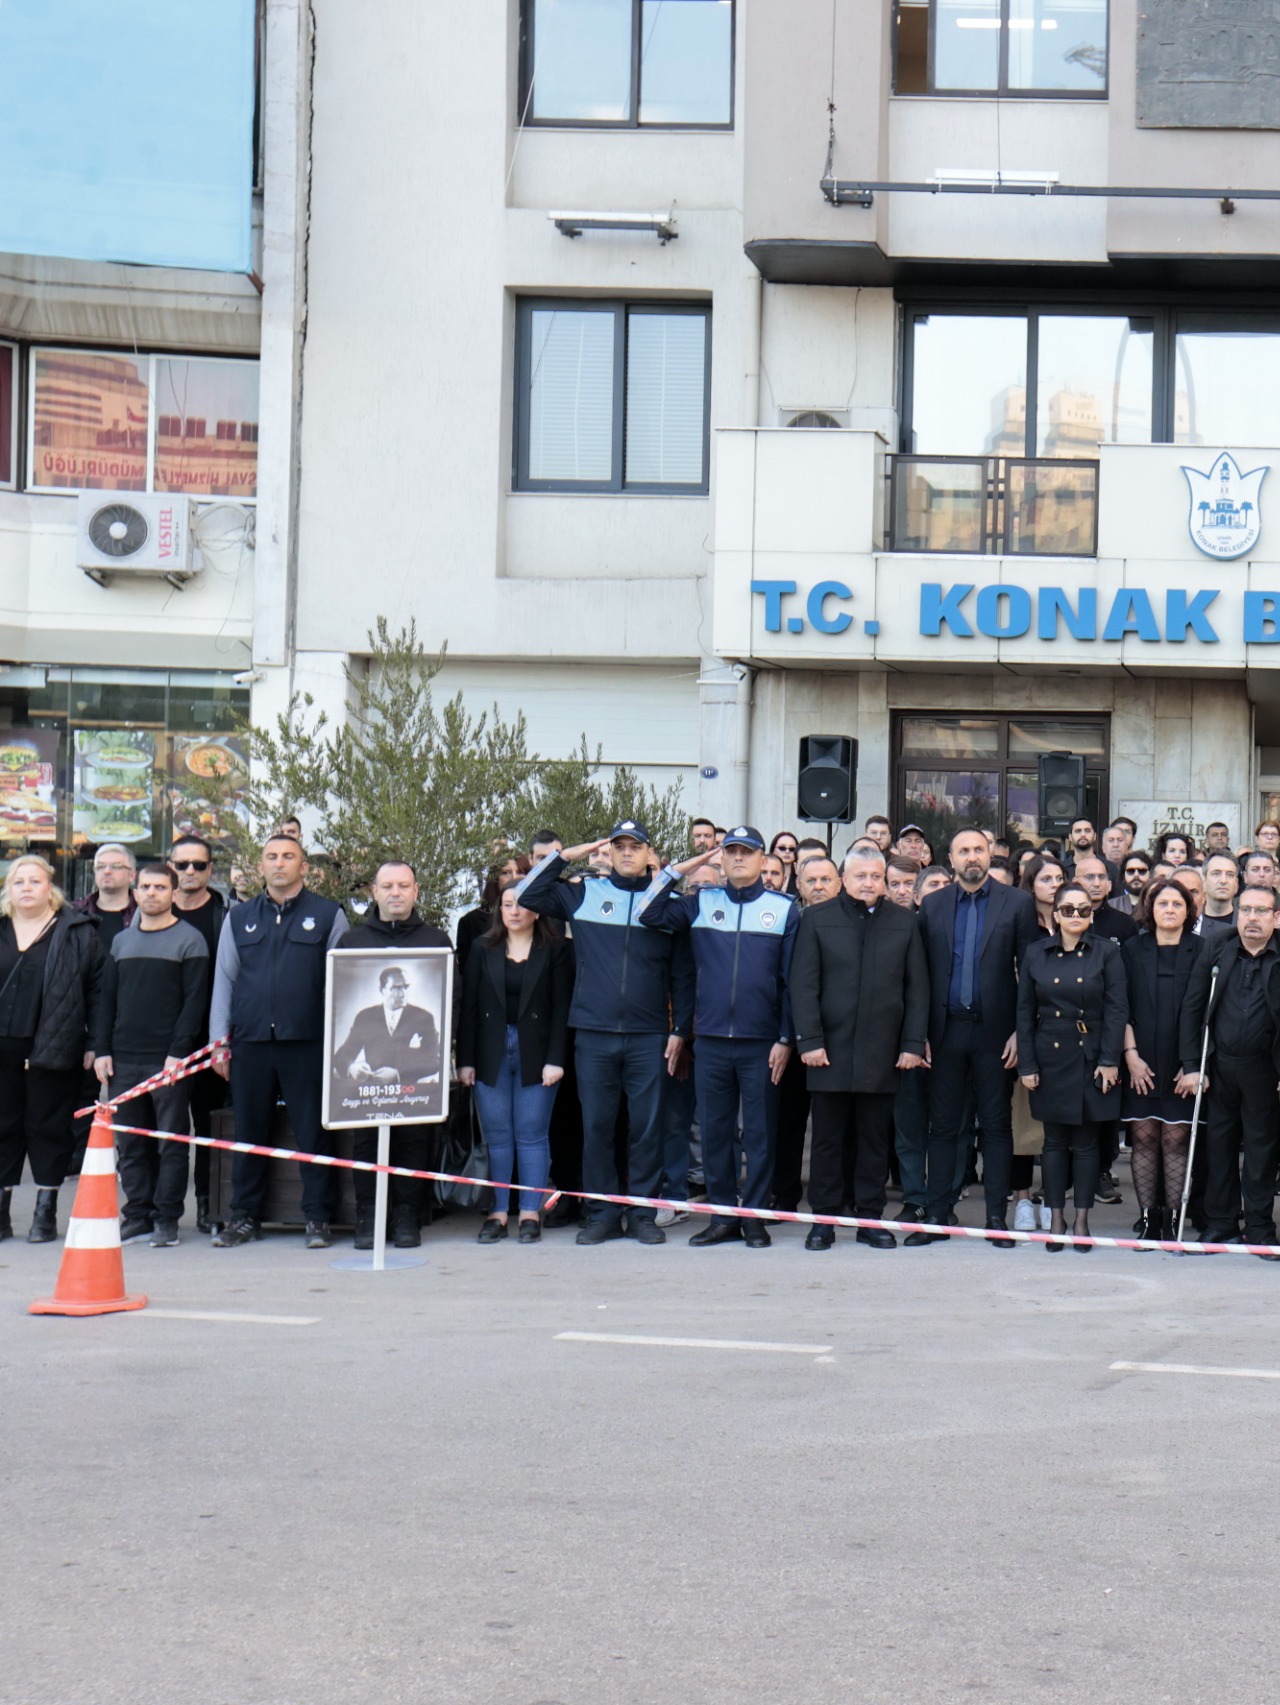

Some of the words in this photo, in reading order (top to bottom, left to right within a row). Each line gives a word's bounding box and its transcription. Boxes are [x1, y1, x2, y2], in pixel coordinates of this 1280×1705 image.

[159, 506, 172, 558] VESTEL
[1196, 529, 1216, 551] KONAK
[750, 579, 879, 636] T.C.
[919, 582, 1221, 643] KONAK
[1167, 806, 1195, 820] T.C.
[1152, 820, 1206, 836] İZMİR
